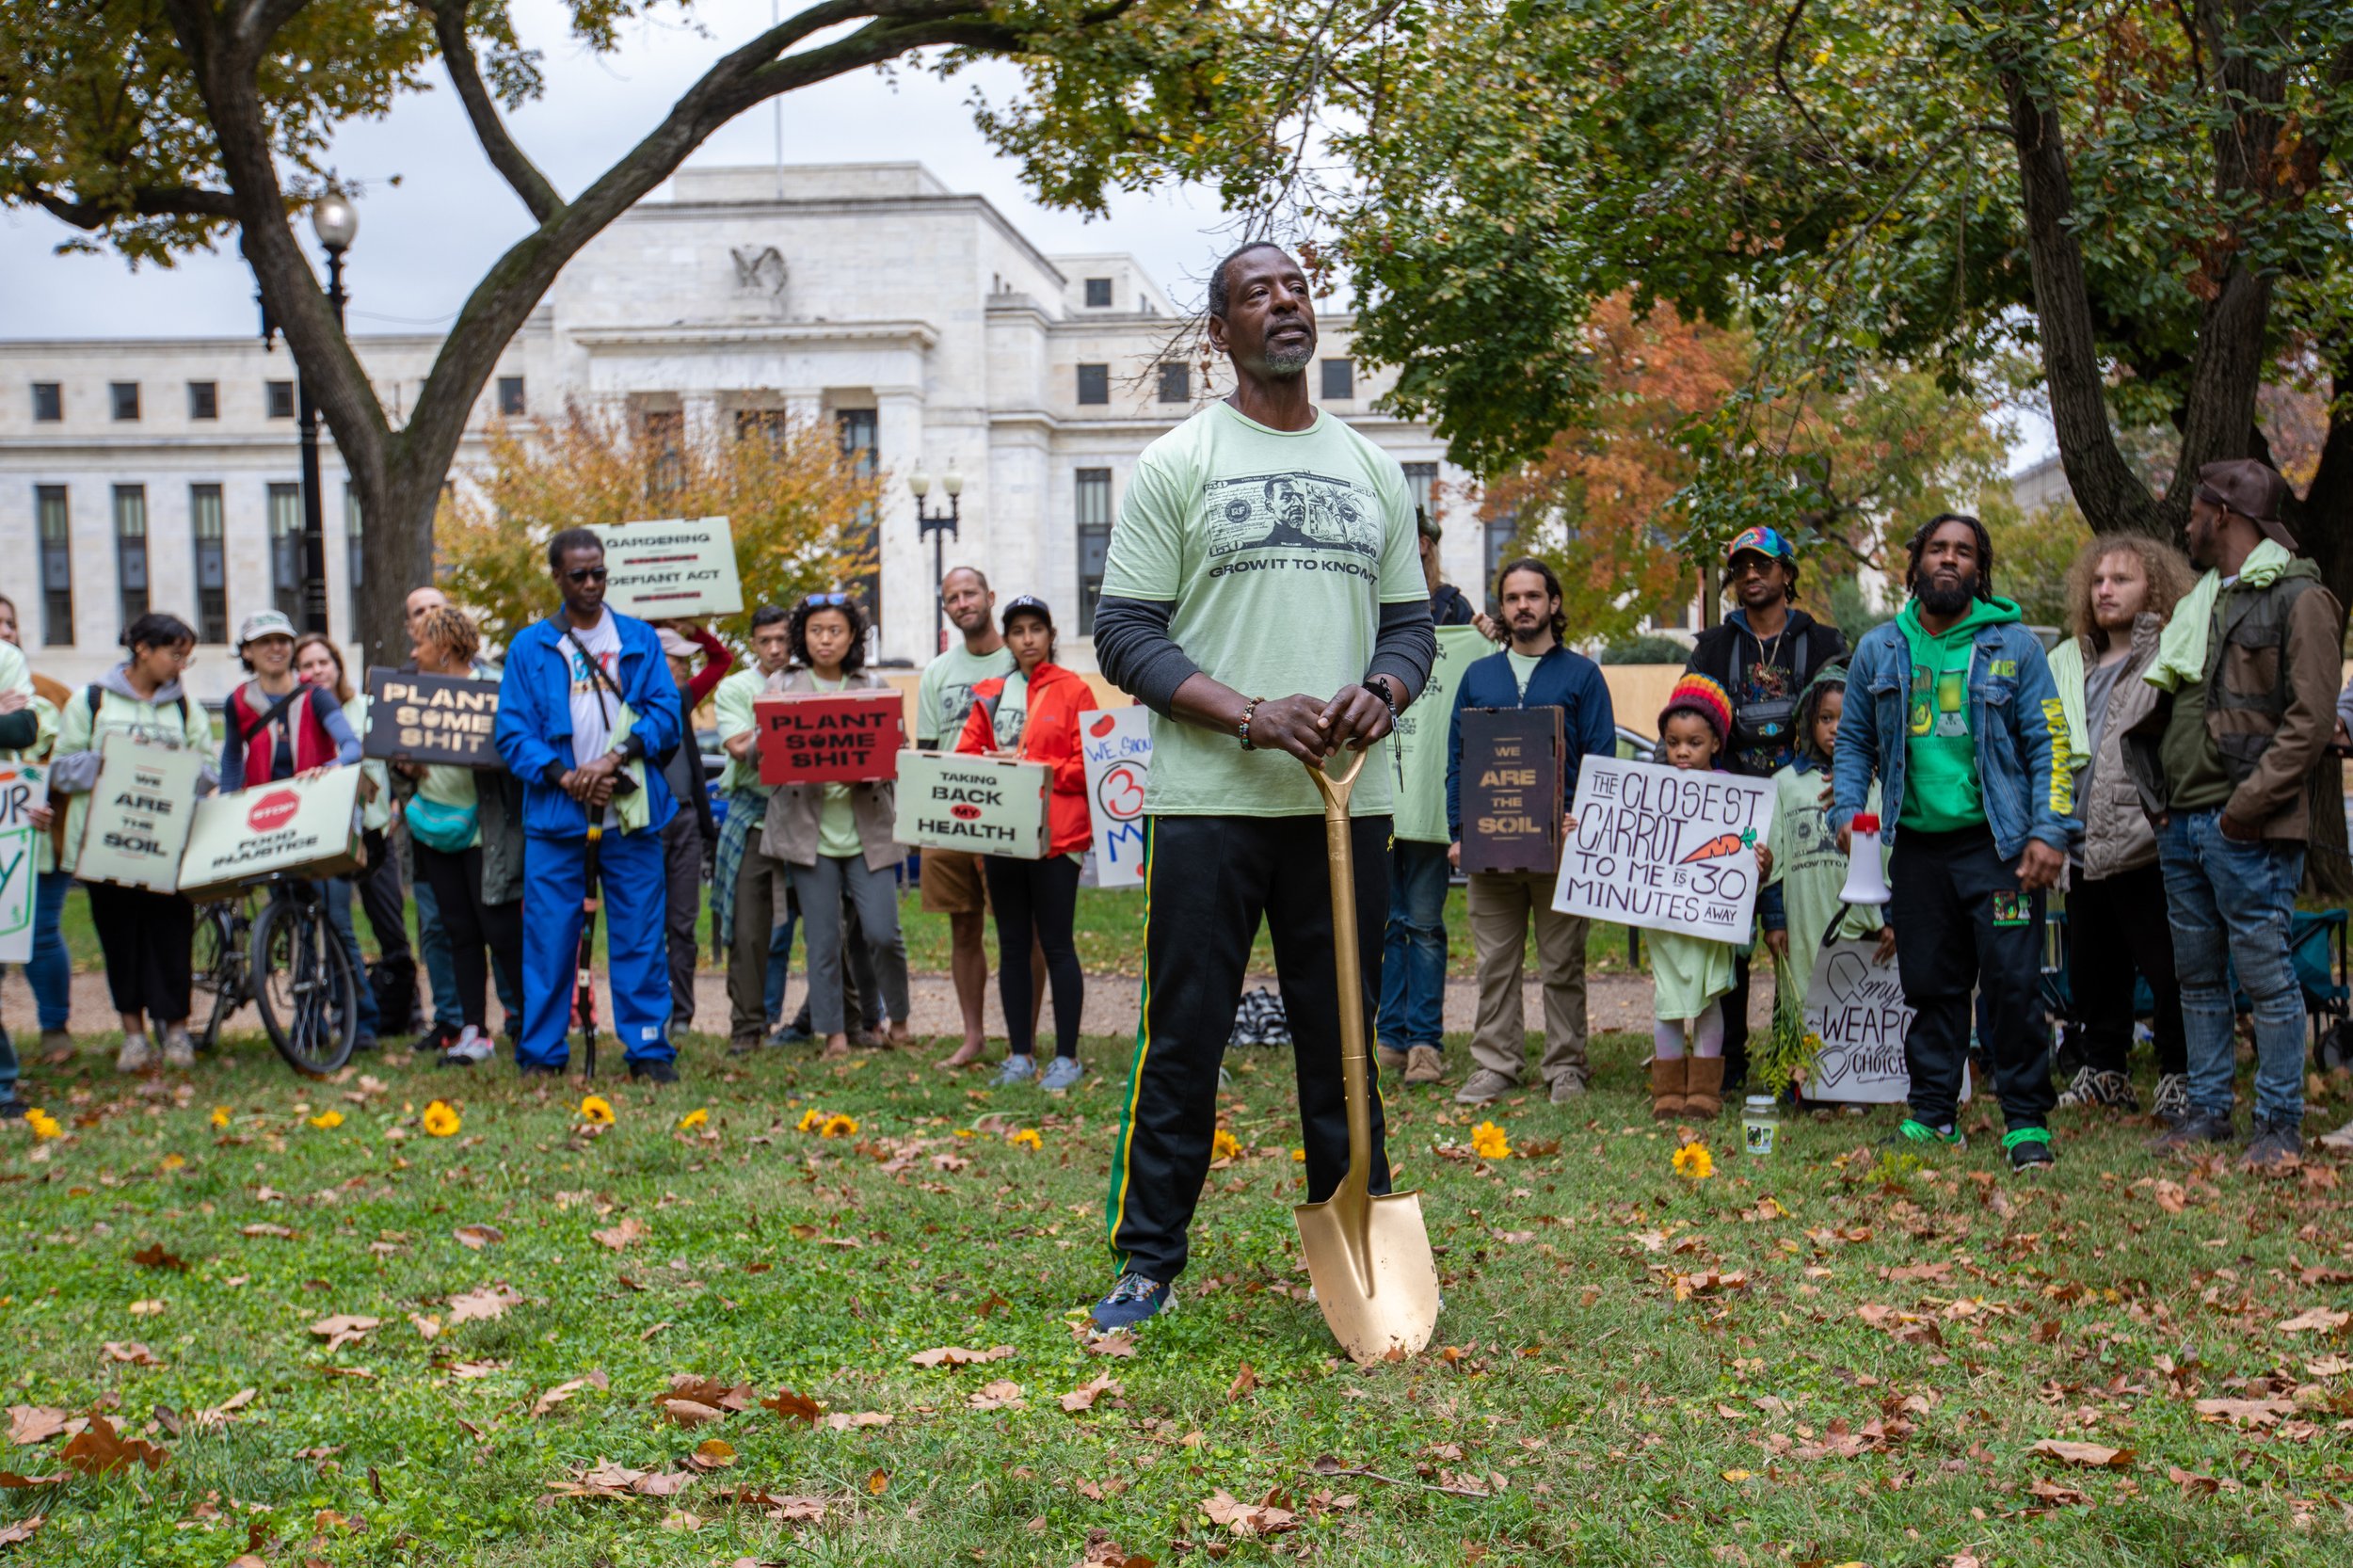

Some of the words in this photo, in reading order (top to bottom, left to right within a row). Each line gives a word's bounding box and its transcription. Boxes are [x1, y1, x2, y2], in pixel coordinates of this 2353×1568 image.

[606, 533, 711, 549] GARDENING
[607, 572, 682, 586] DEFIANT
[687, 569, 721, 580] ACT
[1209, 559, 1270, 579] GROW
[1272, 559, 1288, 569] IT
[1292, 559, 1318, 569] TO
[1321, 560, 1369, 580] KNOW
[383, 682, 500, 712] PLANT
[396, 706, 493, 734] SOME
[772, 712, 888, 731] PLANT
[400, 728, 486, 753] SHIT
[786, 732, 875, 749] SOME
[792, 750, 871, 768] SHIT
[1085, 742, 1116, 762] WE
[1495, 746, 1521, 757] WE
[940, 772, 998, 786] TAKING
[1480, 769, 1536, 787] ARE
[115, 792, 172, 814] ARE
[932, 786, 1003, 806] BACK
[1108, 769, 1144, 816] 3
[1492, 797, 1523, 808] THE
[1593, 774, 1618, 795] THE
[1623, 773, 1764, 826] CLOSEST
[252, 802, 294, 820] STOP
[954, 808, 978, 817] MY
[918, 819, 1016, 841] HEALTH
[1478, 817, 1542, 834] SOIL
[1577, 803, 1689, 865] CARROT
[104, 833, 167, 856] SOIL
[239, 828, 296, 851] FOOD
[212, 835, 318, 869] INJUSTICE
[1576, 850, 1615, 877] TO
[1628, 860, 1666, 888] ME
[1673, 872, 1687, 884] IS
[1691, 862, 1747, 901] 30
[1791, 859, 1818, 872] GROW
[1566, 877, 1700, 923] MINUTES
[1704, 904, 1737, 922] AWAY
[1863, 980, 1905, 1010] my
[1852, 1053, 1909, 1075] CHOICE
